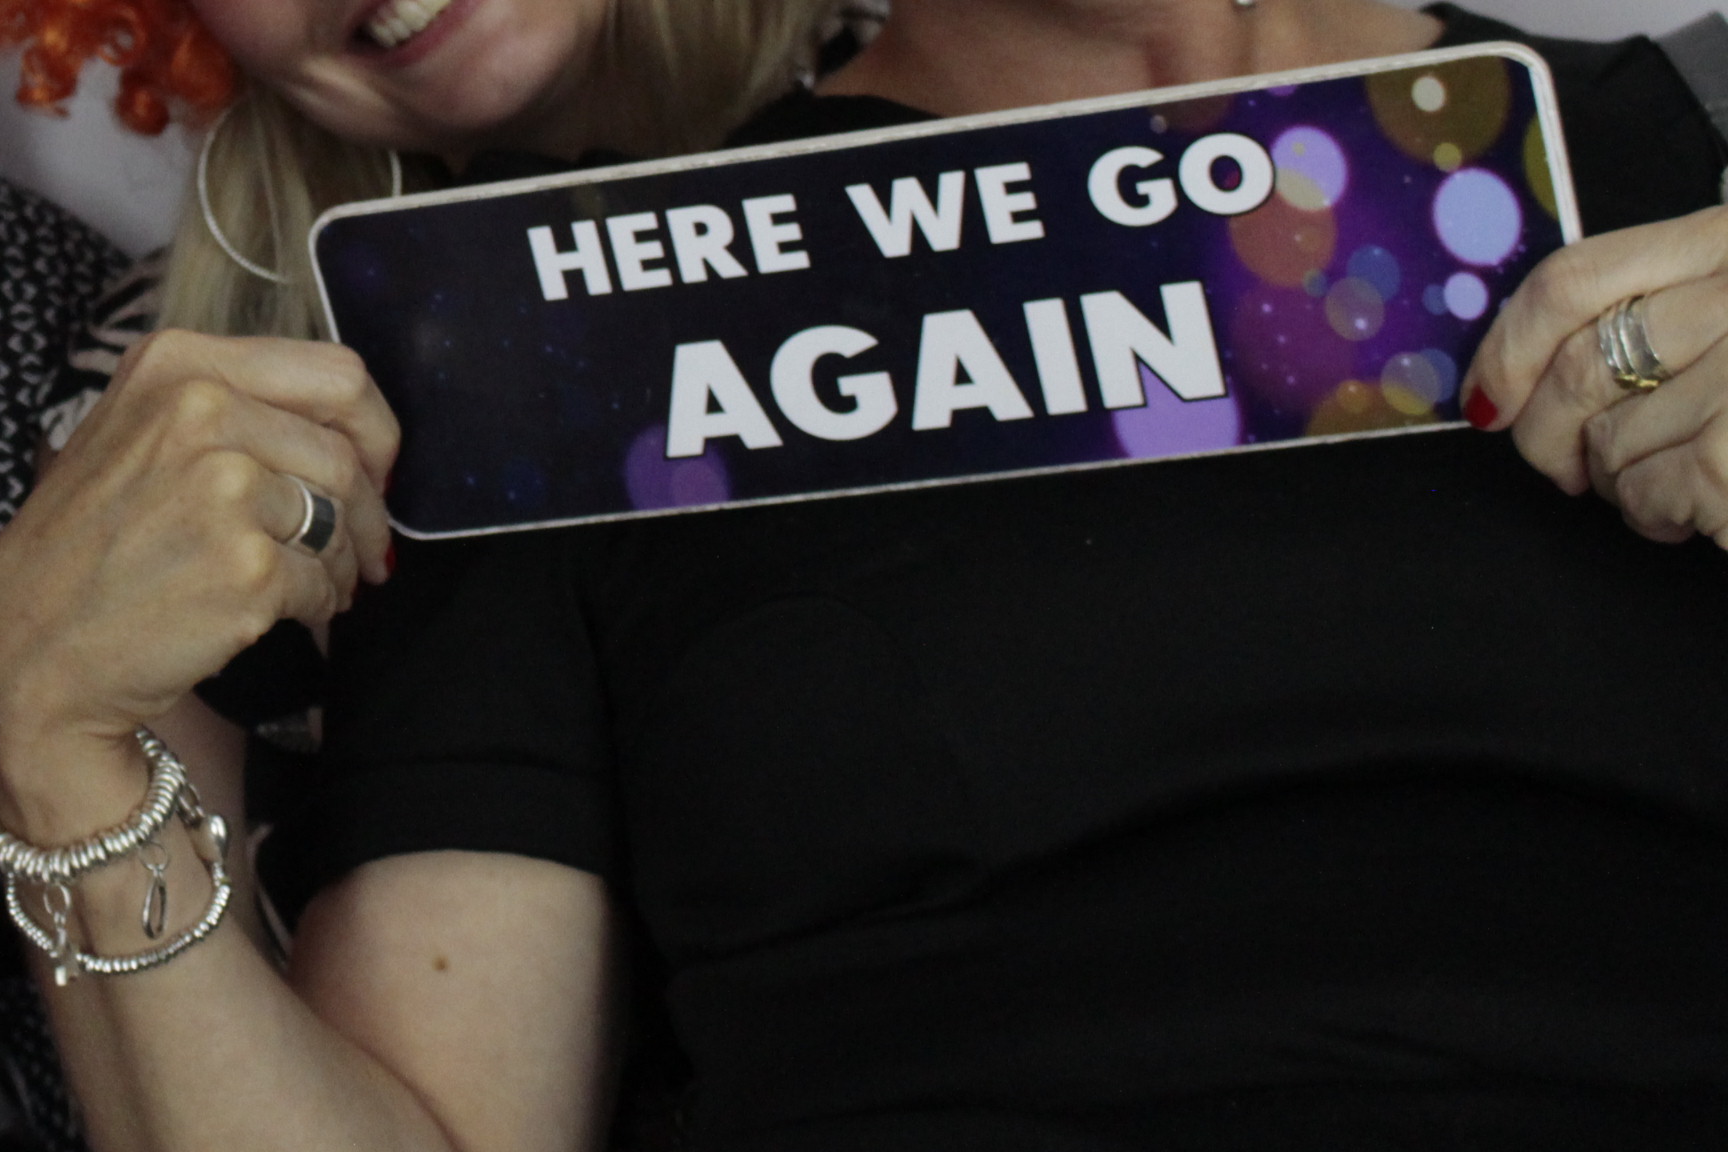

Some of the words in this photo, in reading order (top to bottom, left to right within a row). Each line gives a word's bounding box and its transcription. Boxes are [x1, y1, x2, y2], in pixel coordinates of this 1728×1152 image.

[528, 195, 809, 300] HERE
[847, 163, 1043, 257] WE
[1089, 134, 1272, 226] GO
[668, 282, 1224, 458] AGAIN
